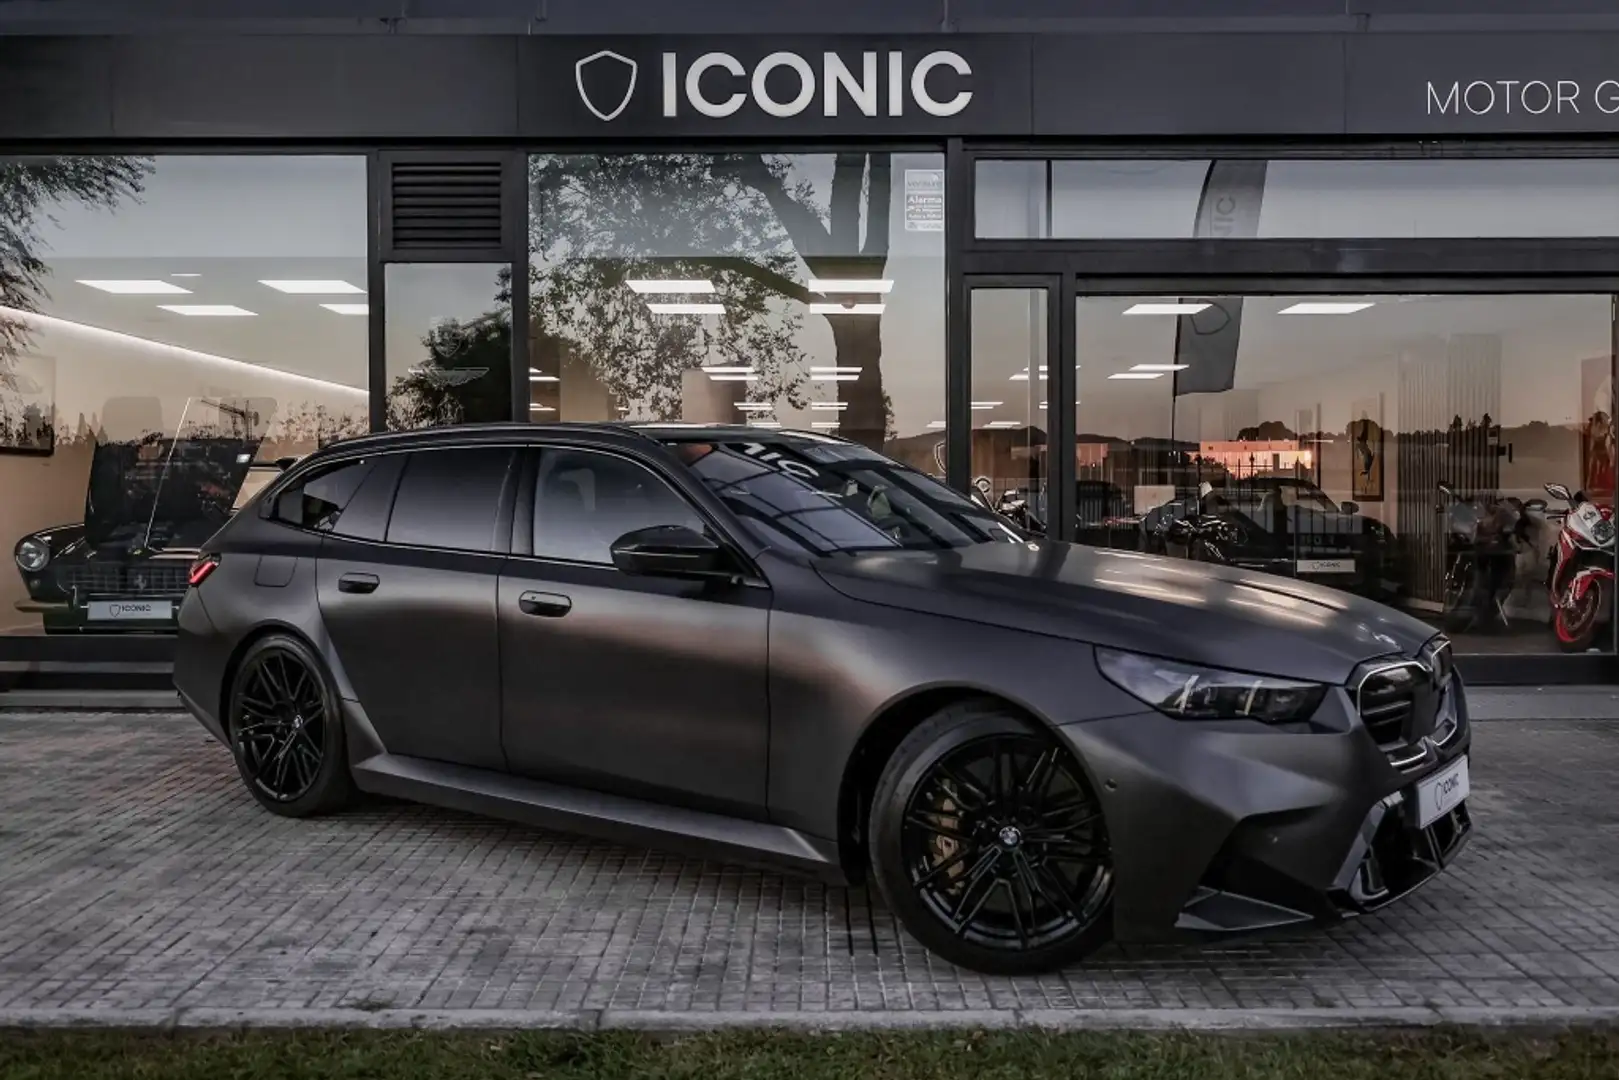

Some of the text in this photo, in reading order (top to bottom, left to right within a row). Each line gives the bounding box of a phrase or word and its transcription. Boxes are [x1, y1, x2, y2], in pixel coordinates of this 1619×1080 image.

[662, 51, 974, 118] ICONIC
[1427, 80, 1580, 115] MOTOR
[122, 604, 152, 612] ICONIC
